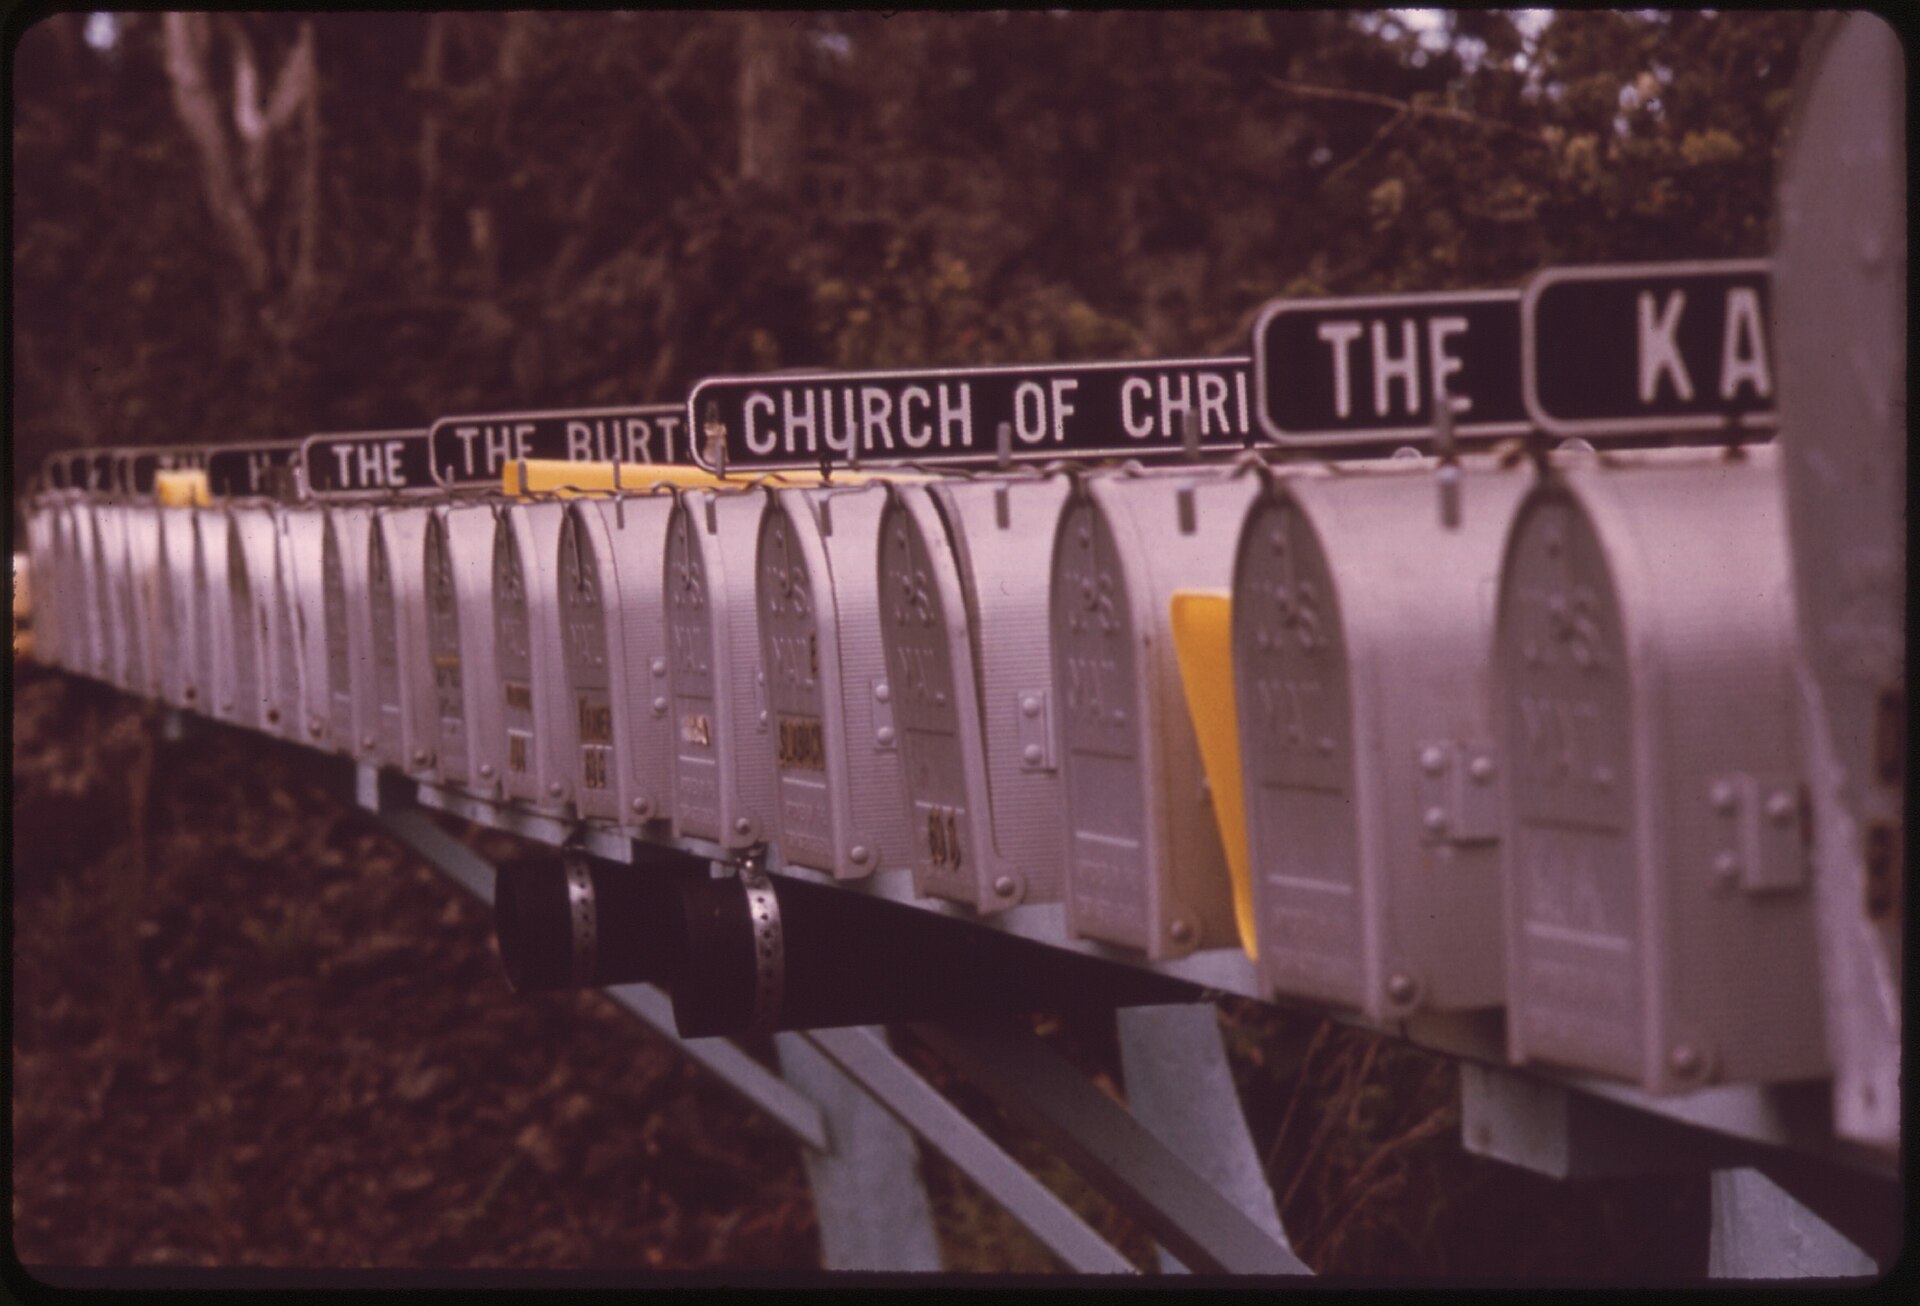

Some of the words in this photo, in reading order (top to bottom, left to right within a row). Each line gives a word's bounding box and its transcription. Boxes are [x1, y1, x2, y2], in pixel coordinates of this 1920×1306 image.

[1316, 316, 1472, 419] THE
[743, 382, 973, 455] CHURCH
[1014, 377, 1078, 444] OF
[332, 442, 406, 488] THE
[455, 424, 536, 476] THE
